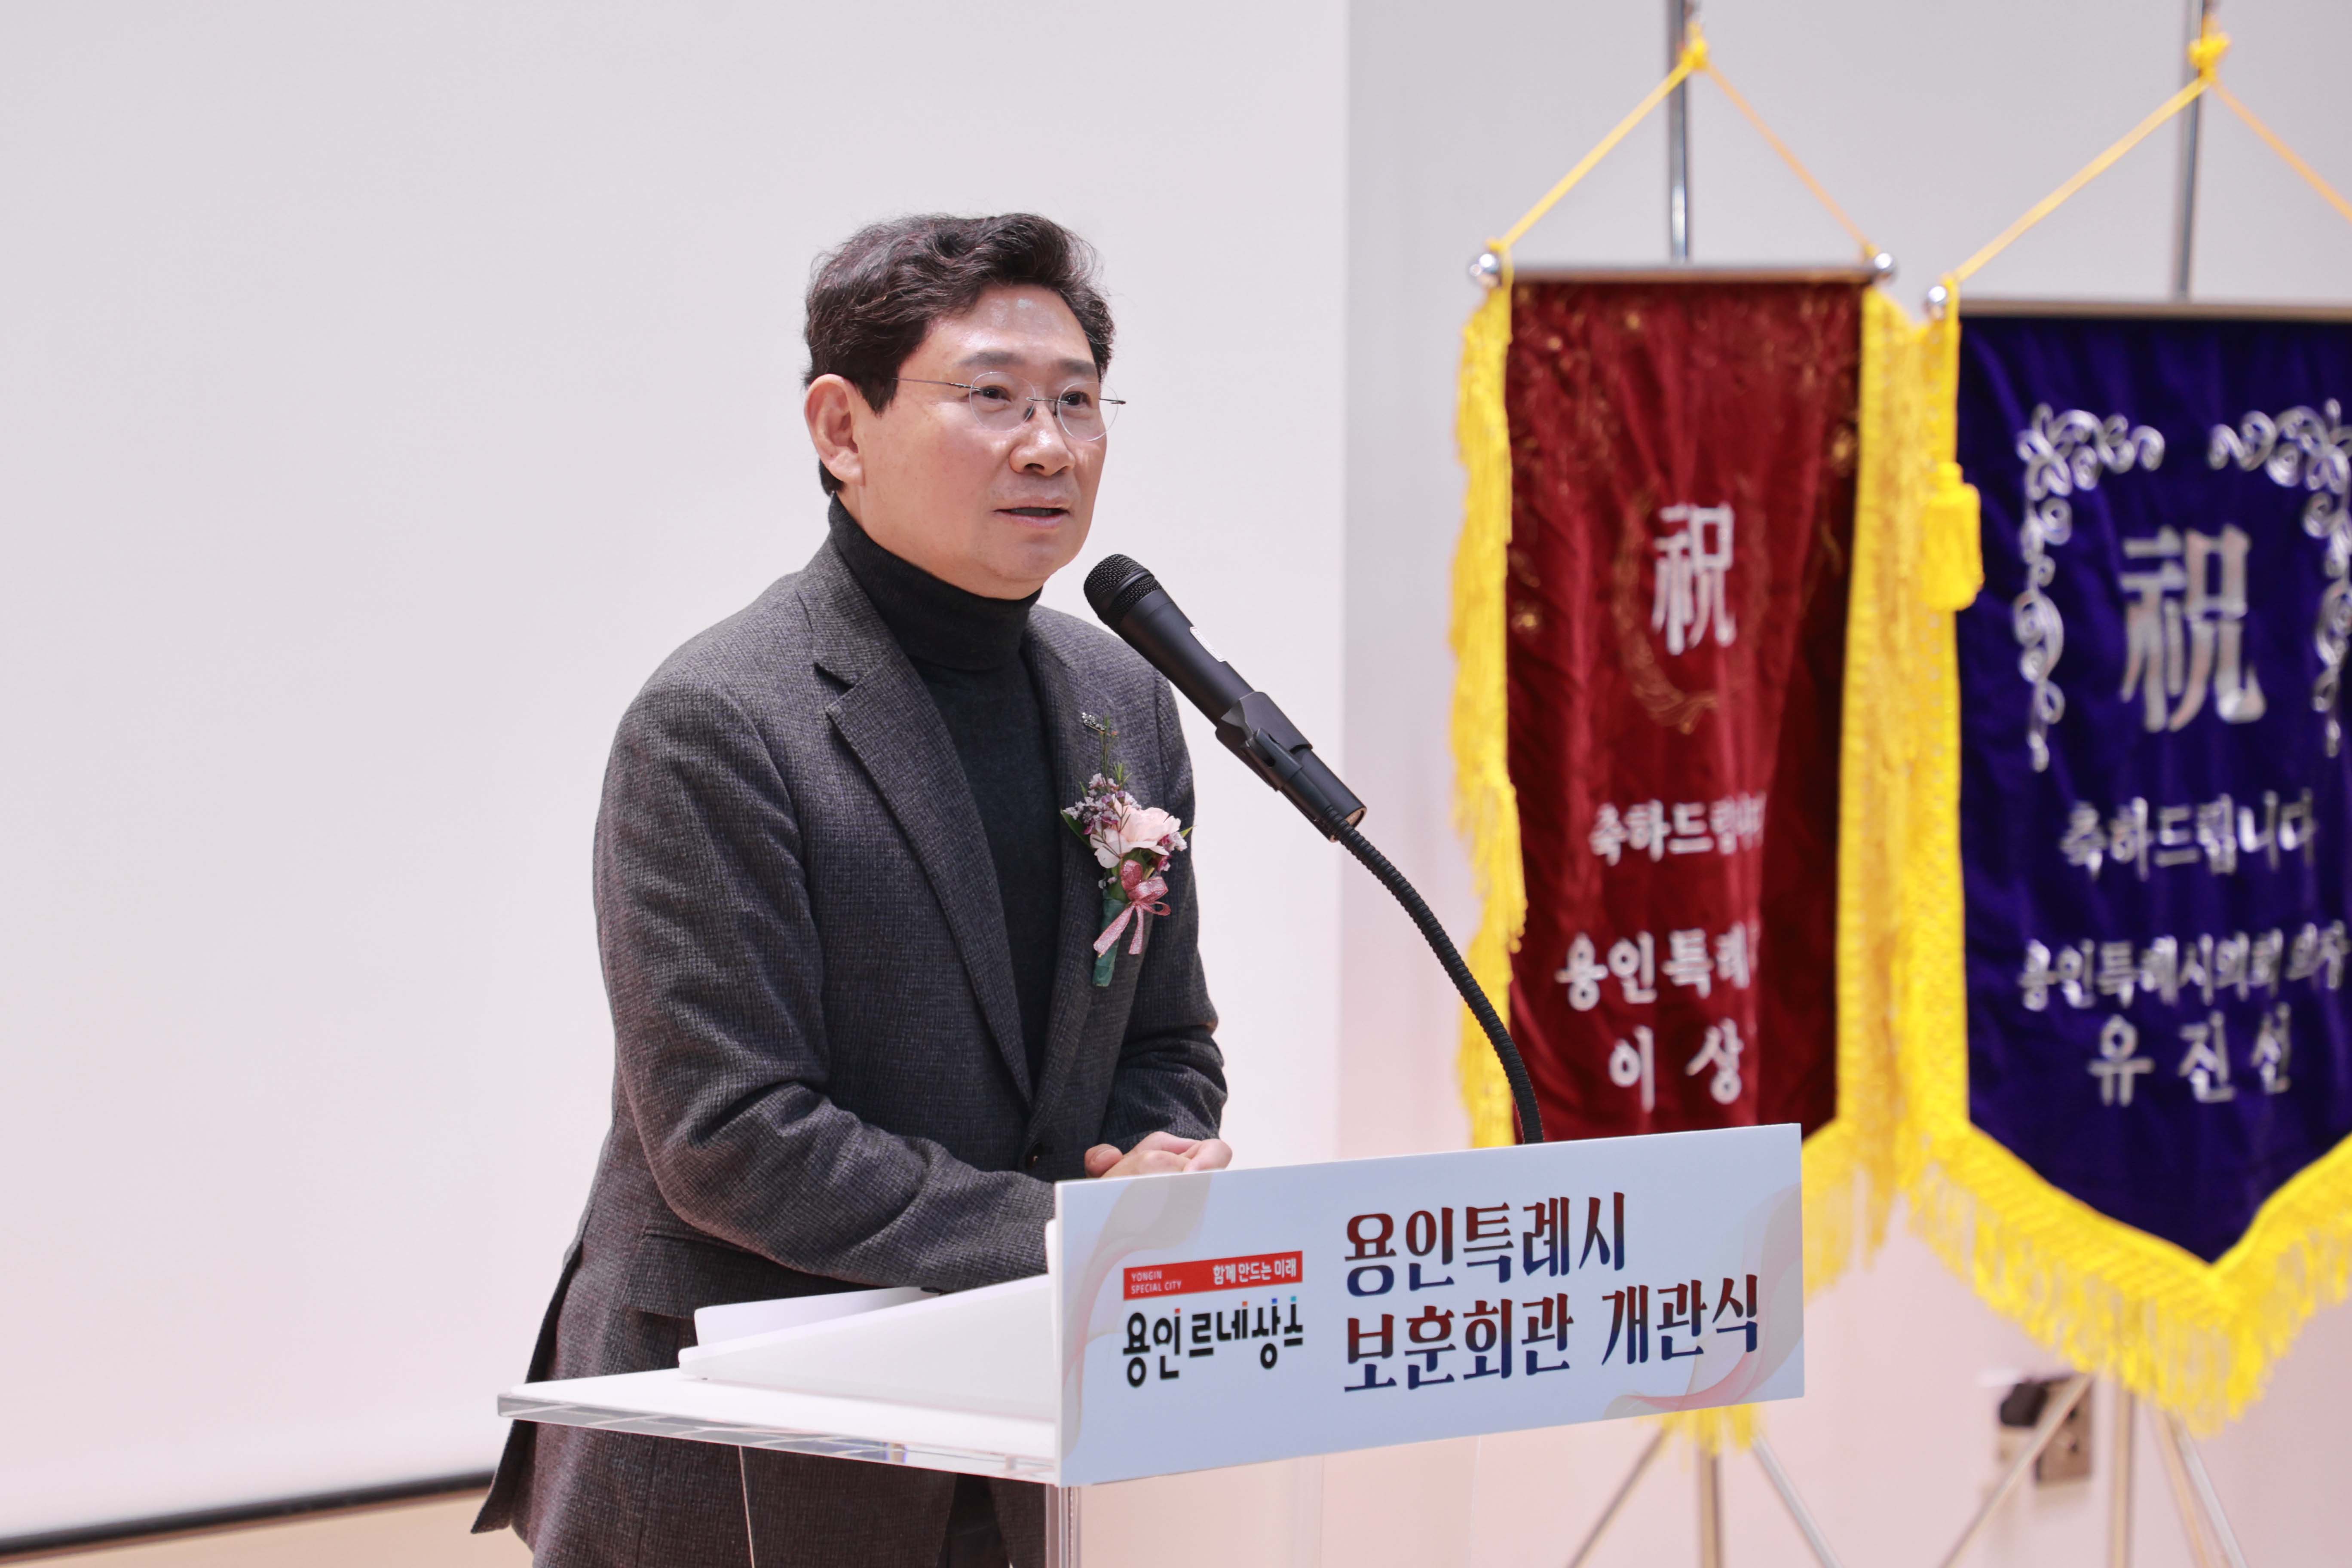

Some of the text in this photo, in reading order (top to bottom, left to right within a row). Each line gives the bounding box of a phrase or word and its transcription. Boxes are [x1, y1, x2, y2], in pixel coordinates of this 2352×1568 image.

[1651, 501, 1736, 655] 祝
[2119, 524, 2267, 732] 祝
[2061, 787, 2318, 881] 축하드립니다
[1131, 1270, 1162, 1282] YONGIN
[1131, 1280, 1182, 1294] SPECIAL CITY
[1213, 1258, 1296, 1285] 함께 만드는 미래
[1344, 1191, 1625, 1297] 용인특례시
[1344, 1274, 1758, 1392] 보훈회관 개관식
